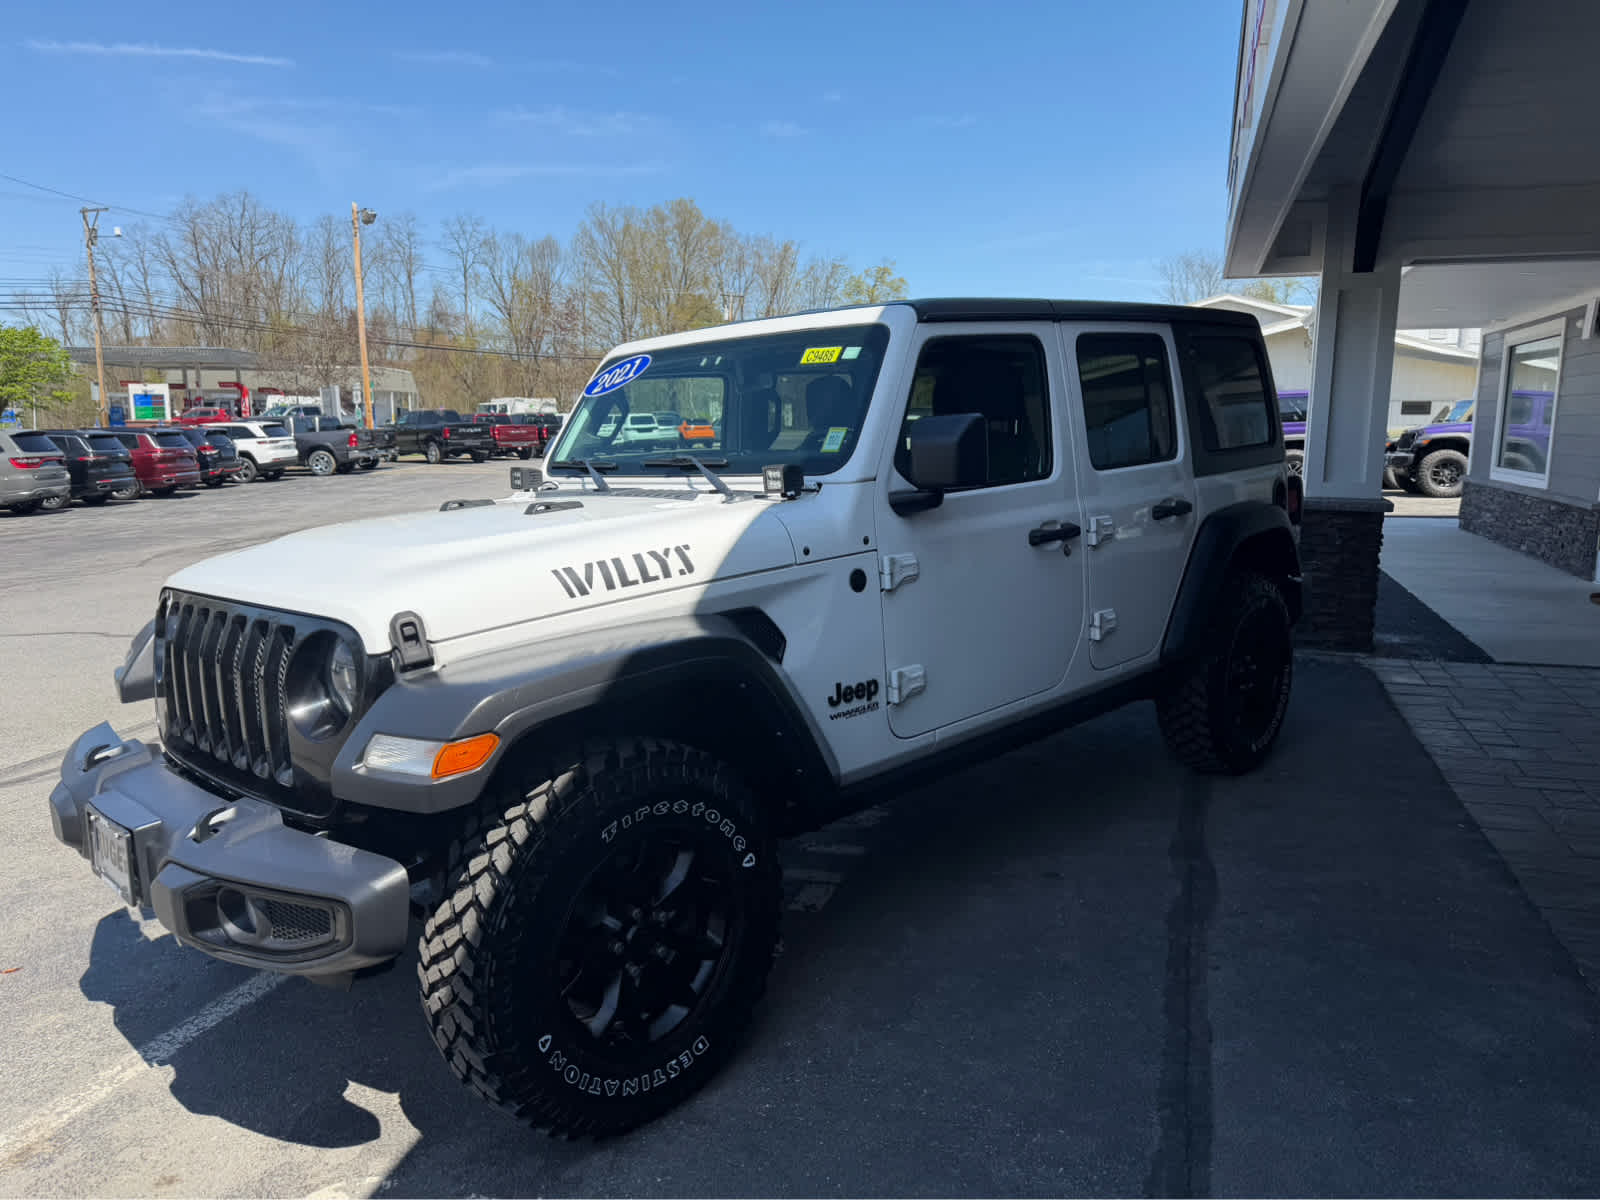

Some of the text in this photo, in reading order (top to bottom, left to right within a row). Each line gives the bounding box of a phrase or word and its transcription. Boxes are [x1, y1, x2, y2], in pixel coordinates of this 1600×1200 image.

[591, 357, 643, 394] 2021
[551, 544, 695, 598] WILLYS
[827, 678, 879, 708] Jeep
[601, 799, 746, 852] Firestone
[549, 1035, 710, 1097] DESTINATION
